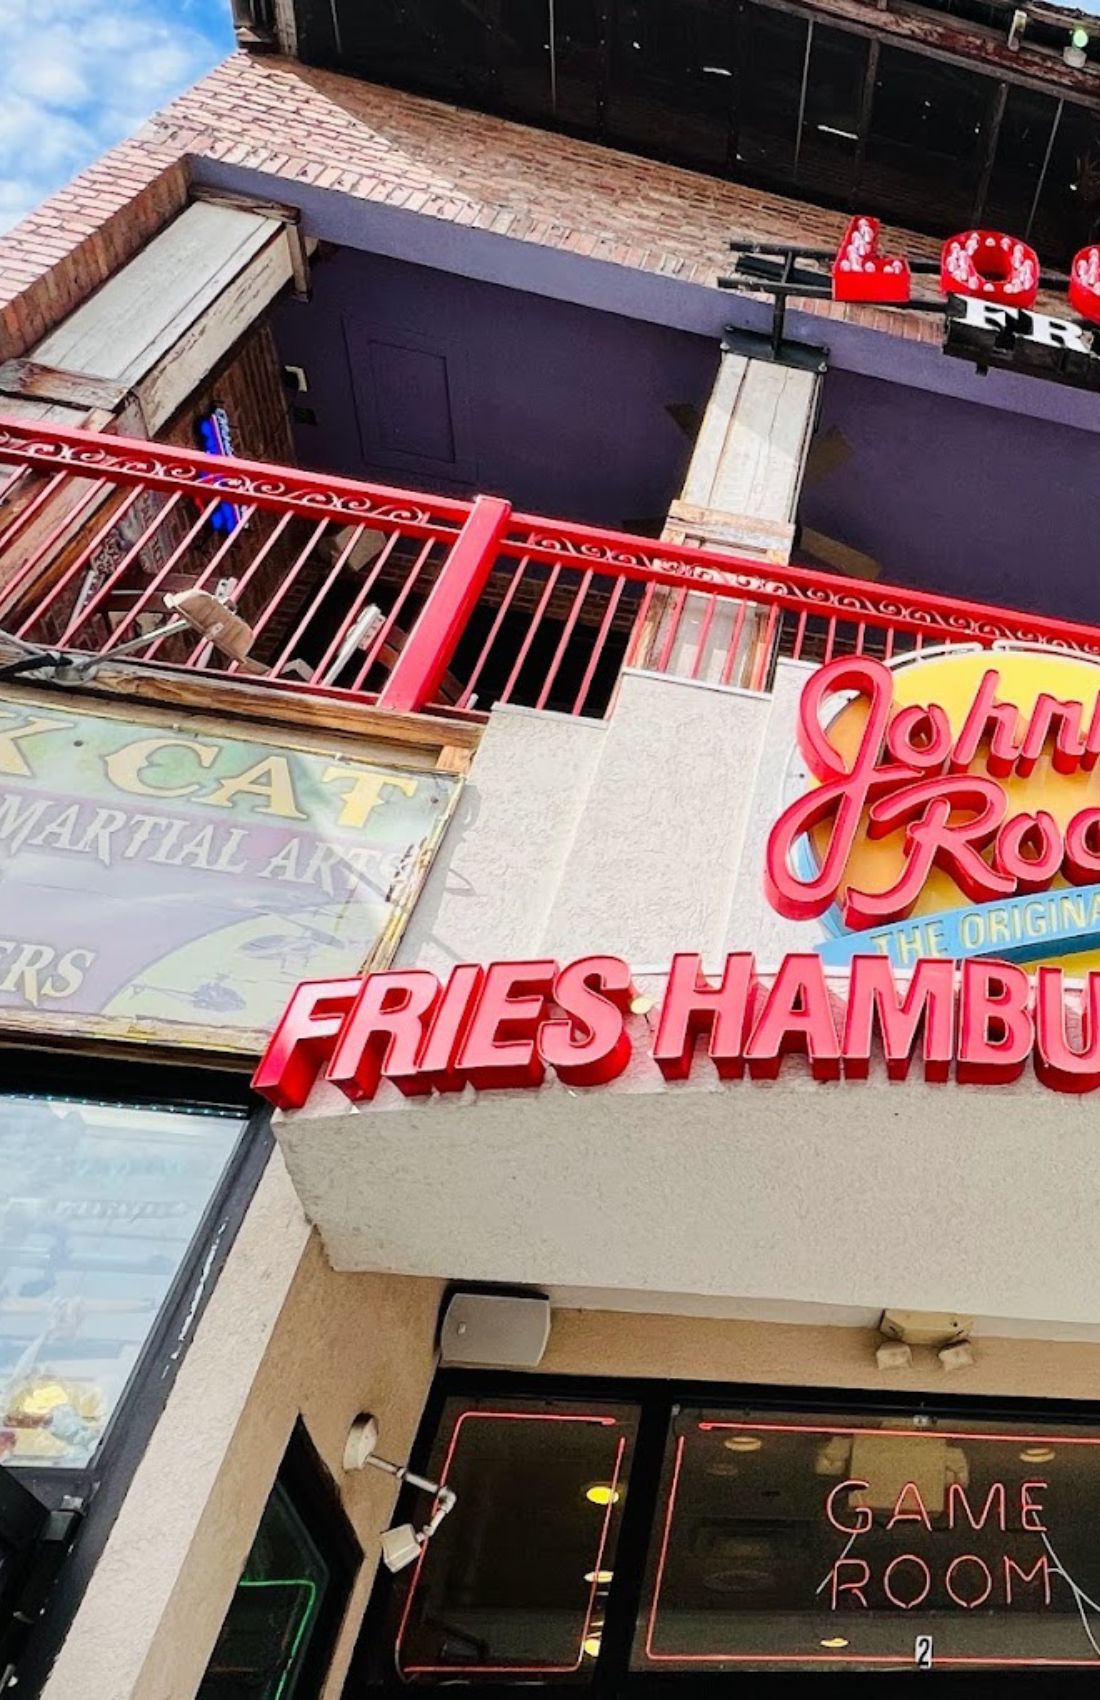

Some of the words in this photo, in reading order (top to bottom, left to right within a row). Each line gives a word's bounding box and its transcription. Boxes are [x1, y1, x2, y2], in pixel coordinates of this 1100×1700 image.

[103, 738, 417, 829] CAT
[0, 795, 249, 867] MARTIAL
[870, 922, 949, 967] THE
[250, 955, 634, 1109] FRIES
[827, 1480, 1048, 1533] GAME
[832, 1553, 1051, 1609] ROOM
[917, 1638, 931, 1667] 2
